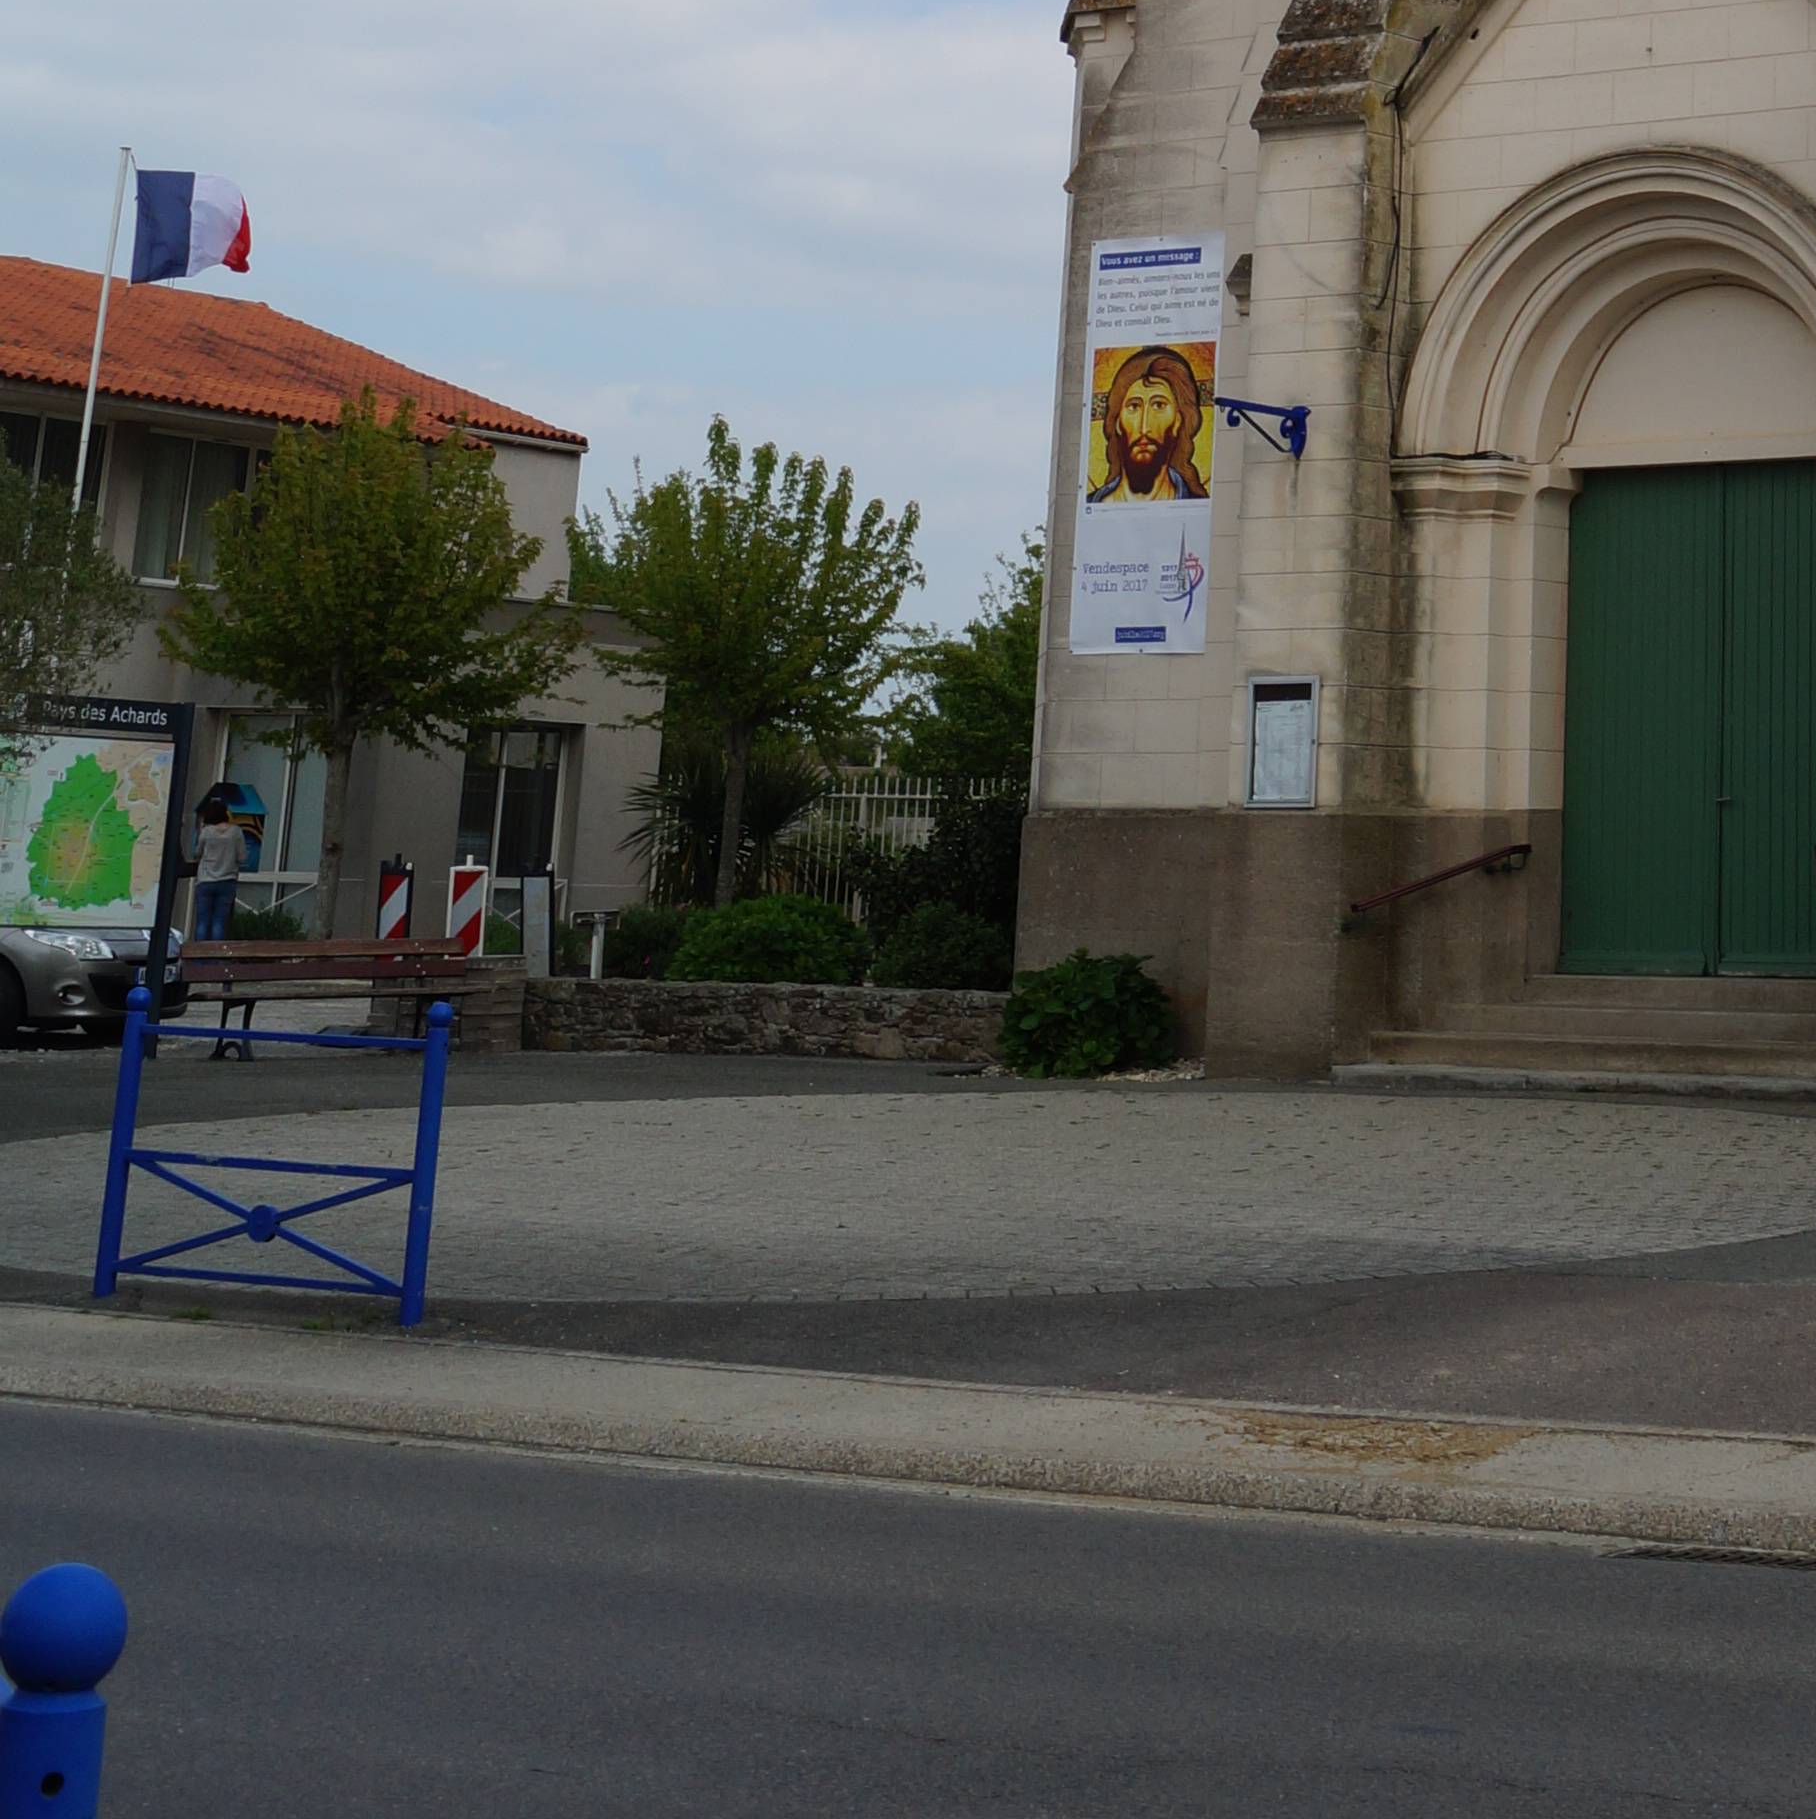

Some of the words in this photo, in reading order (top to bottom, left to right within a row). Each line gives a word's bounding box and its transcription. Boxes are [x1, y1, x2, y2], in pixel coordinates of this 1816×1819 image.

[1101, 256, 1121, 266] Vous
[1123, 256, 1143, 264] avez
[1145, 254, 1155, 263] un
[1158, 252, 1194, 262] message
[1082, 562, 1149, 576] Vendespace
[1081, 582, 1087, 592] 4
[1091, 580, 1118, 594] juin
[1122, 579, 1148, 592] 2017
[80, 703, 106, 721] des
[110, 706, 168, 726] Achards
